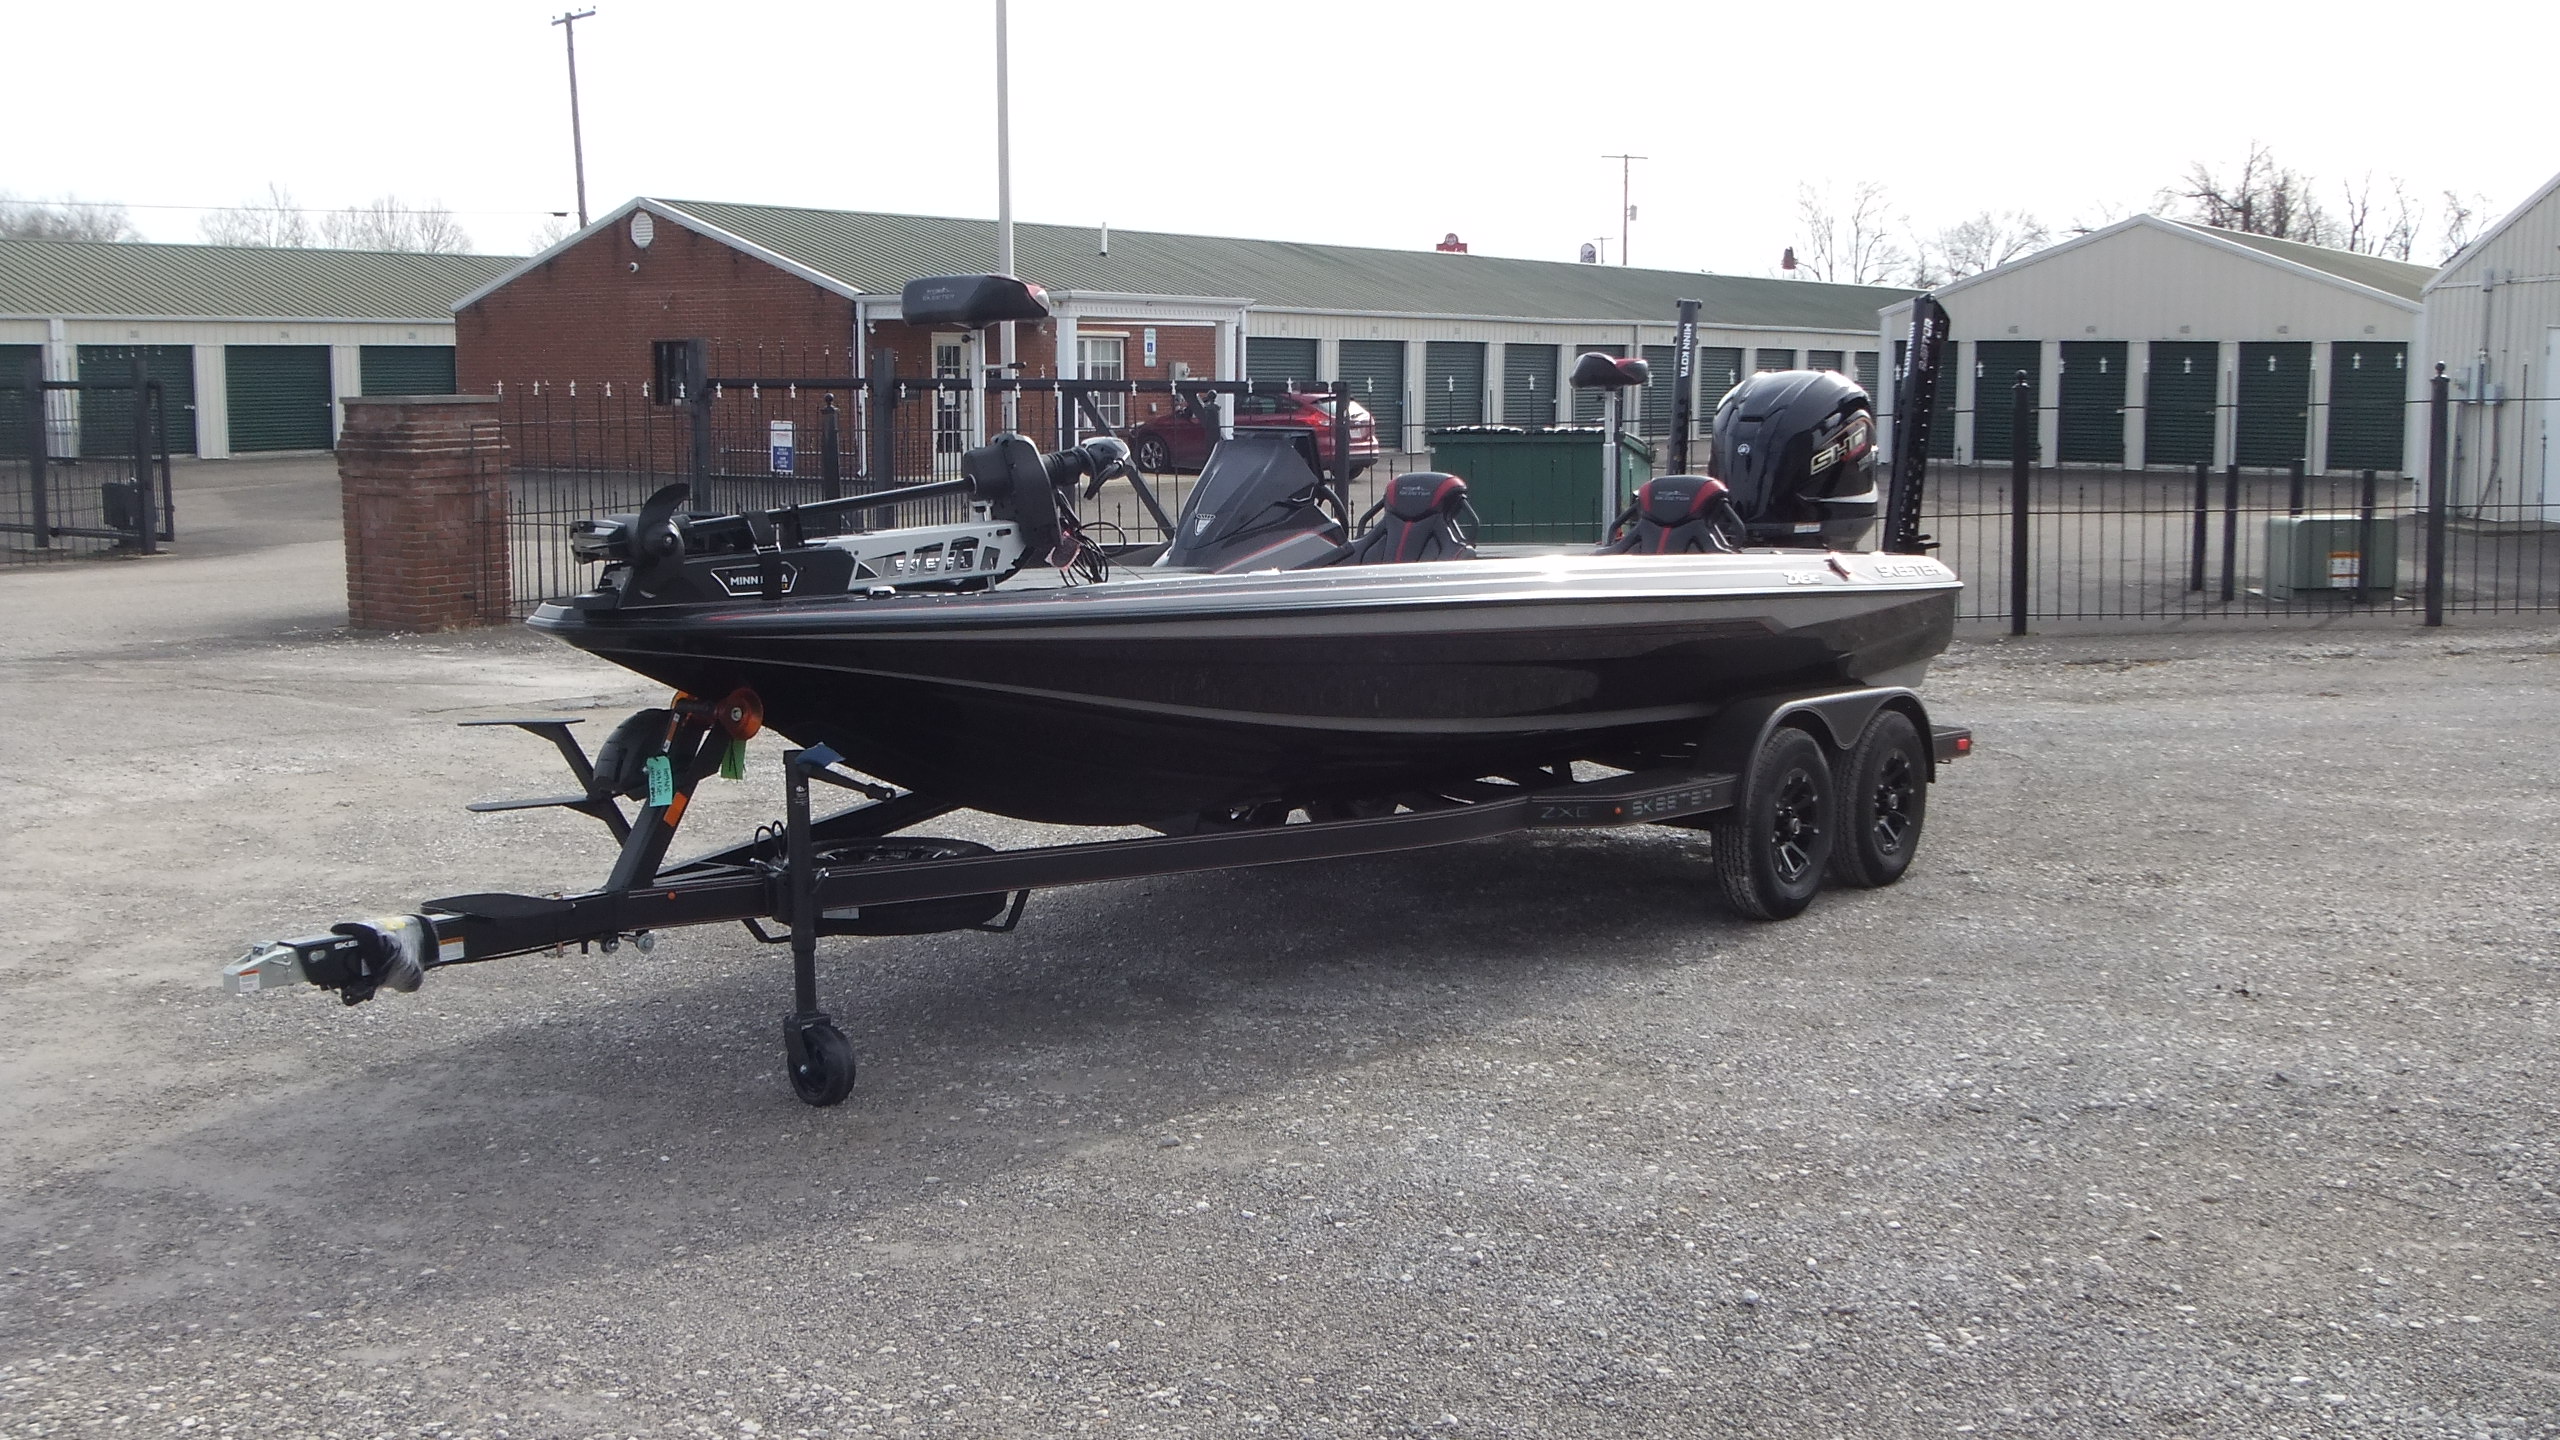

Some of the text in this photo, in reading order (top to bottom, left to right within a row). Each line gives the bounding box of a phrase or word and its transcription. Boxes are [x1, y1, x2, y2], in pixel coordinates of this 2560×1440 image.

[1680, 323, 1692, 378] MINN KOTA
[1907, 321, 1916, 350] MINN
[1810, 426, 1868, 475] SHO
[730, 575, 759, 586] MINN
